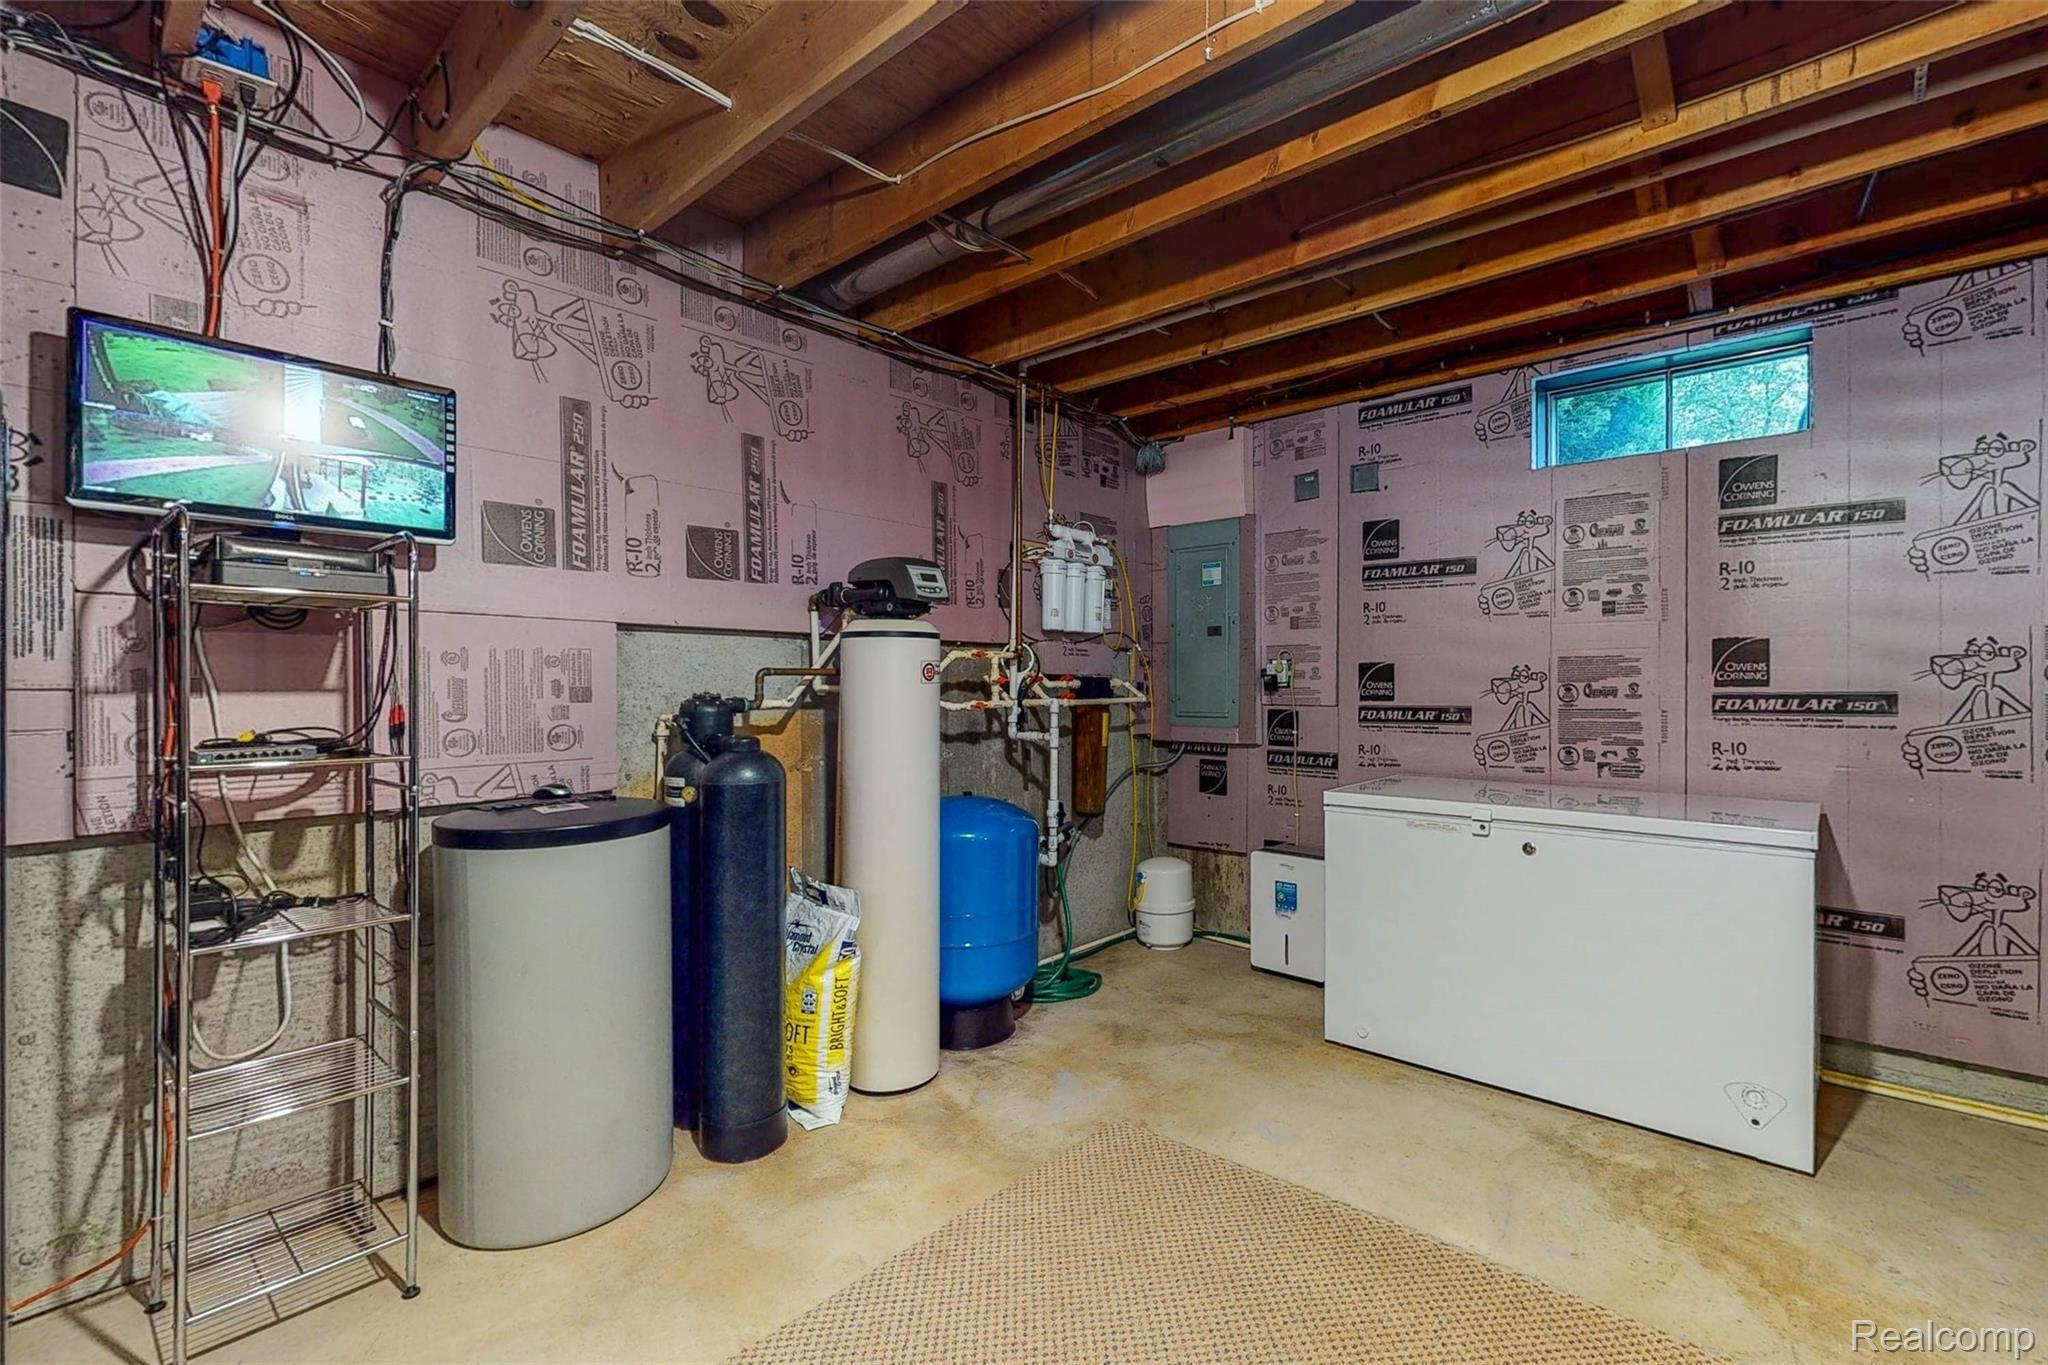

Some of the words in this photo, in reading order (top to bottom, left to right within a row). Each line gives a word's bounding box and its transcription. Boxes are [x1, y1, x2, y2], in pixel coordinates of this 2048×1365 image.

[1359, 396, 1436, 421] FOAMULAR
[1440, 393, 1461, 405] 150
[573, 411, 585, 446] 250
[1358, 443, 1382, 458] R-10
[750, 447, 760, 475] 250
[1732, 480, 1775, 493] OWENS
[1723, 490, 1775, 502] CORNING
[569, 451, 588, 570] FOAMULAR
[1720, 510, 1843, 533] FOAMULAR
[1853, 509, 1886, 521] 150
[519, 509, 534, 553] OWENS
[533, 511, 546, 563] CORNING
[749, 480, 763, 581] FOAMULAR
[625, 537, 643, 572] R-10
[713, 530, 723, 568] OWENS
[723, 531, 732, 577] CORNING
[1365, 547, 1398, 555] CORNING
[792, 554, 804, 585] R-10
[1363, 564, 1440, 579] FOAMULAR
[1445, 564, 1465, 573] 150
[1719, 561, 1755, 576] R-10
[1720, 578, 1730, 591] 2
[1363, 601, 1386, 613] R-10
[1363, 614, 1370, 625] 2
[1725, 662, 1767, 671] OWENS
[1716, 671, 1767, 681] CORNING
[1361, 688, 1393, 696] CORNING
[1366, 681, 1393, 689] OWENS
[1714, 698, 1837, 711] FOAMULAR
[1847, 701, 1877, 711] 150
[1359, 710, 1436, 721] FOAMULAR
[1440, 713, 1460, 721] 150
[1358, 744, 1380, 755] R-10
[1712, 742, 1747, 755] R-10
[1267, 784, 1287, 795] R-10
[1267, 796, 1274, 807] 2
[1852, 919, 1885, 933] 150
[792, 941, 819, 955] Crystal
[785, 1022, 810, 1044] OFT
